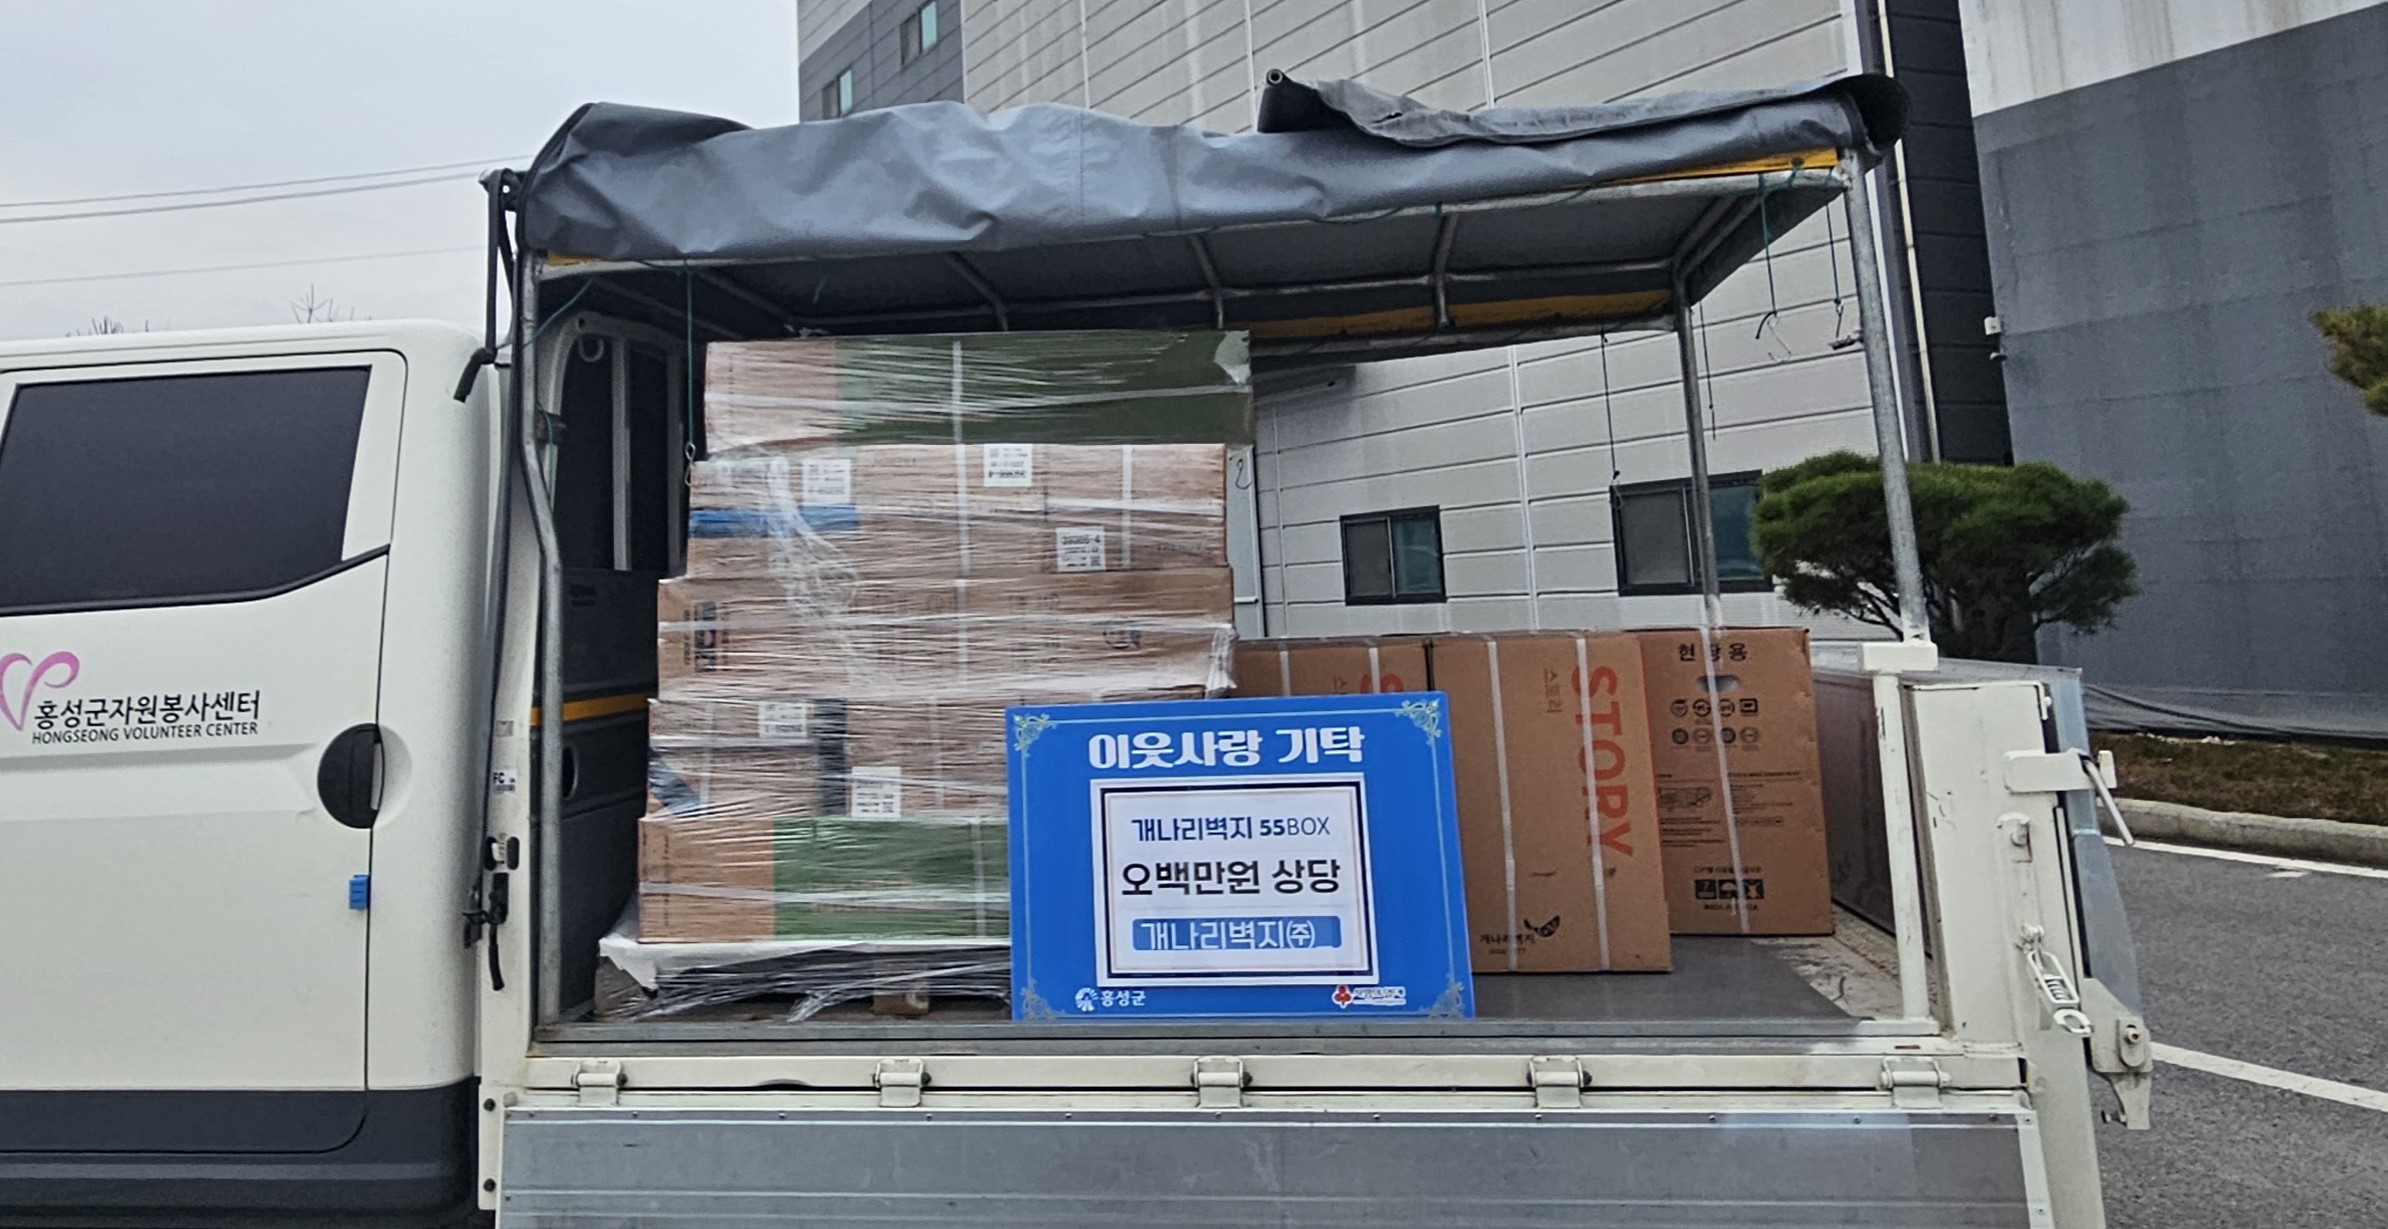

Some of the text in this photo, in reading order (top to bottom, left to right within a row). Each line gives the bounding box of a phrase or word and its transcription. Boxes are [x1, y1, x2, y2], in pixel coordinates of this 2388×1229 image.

[34, 690, 260, 730] 홍성군자원봉사센터
[32, 721, 258, 744] HONGSEONG VOLUNTEER CENTER
[1088, 726, 1365, 769] 이웃사랑 기탁
[1571, 666, 1634, 857] STORY
[1131, 816, 1331, 842] 개나리벽지 55BOX
[1122, 858, 1341, 896] 오백만원 상당
[1101, 989, 1146, 1007] 홍성군
